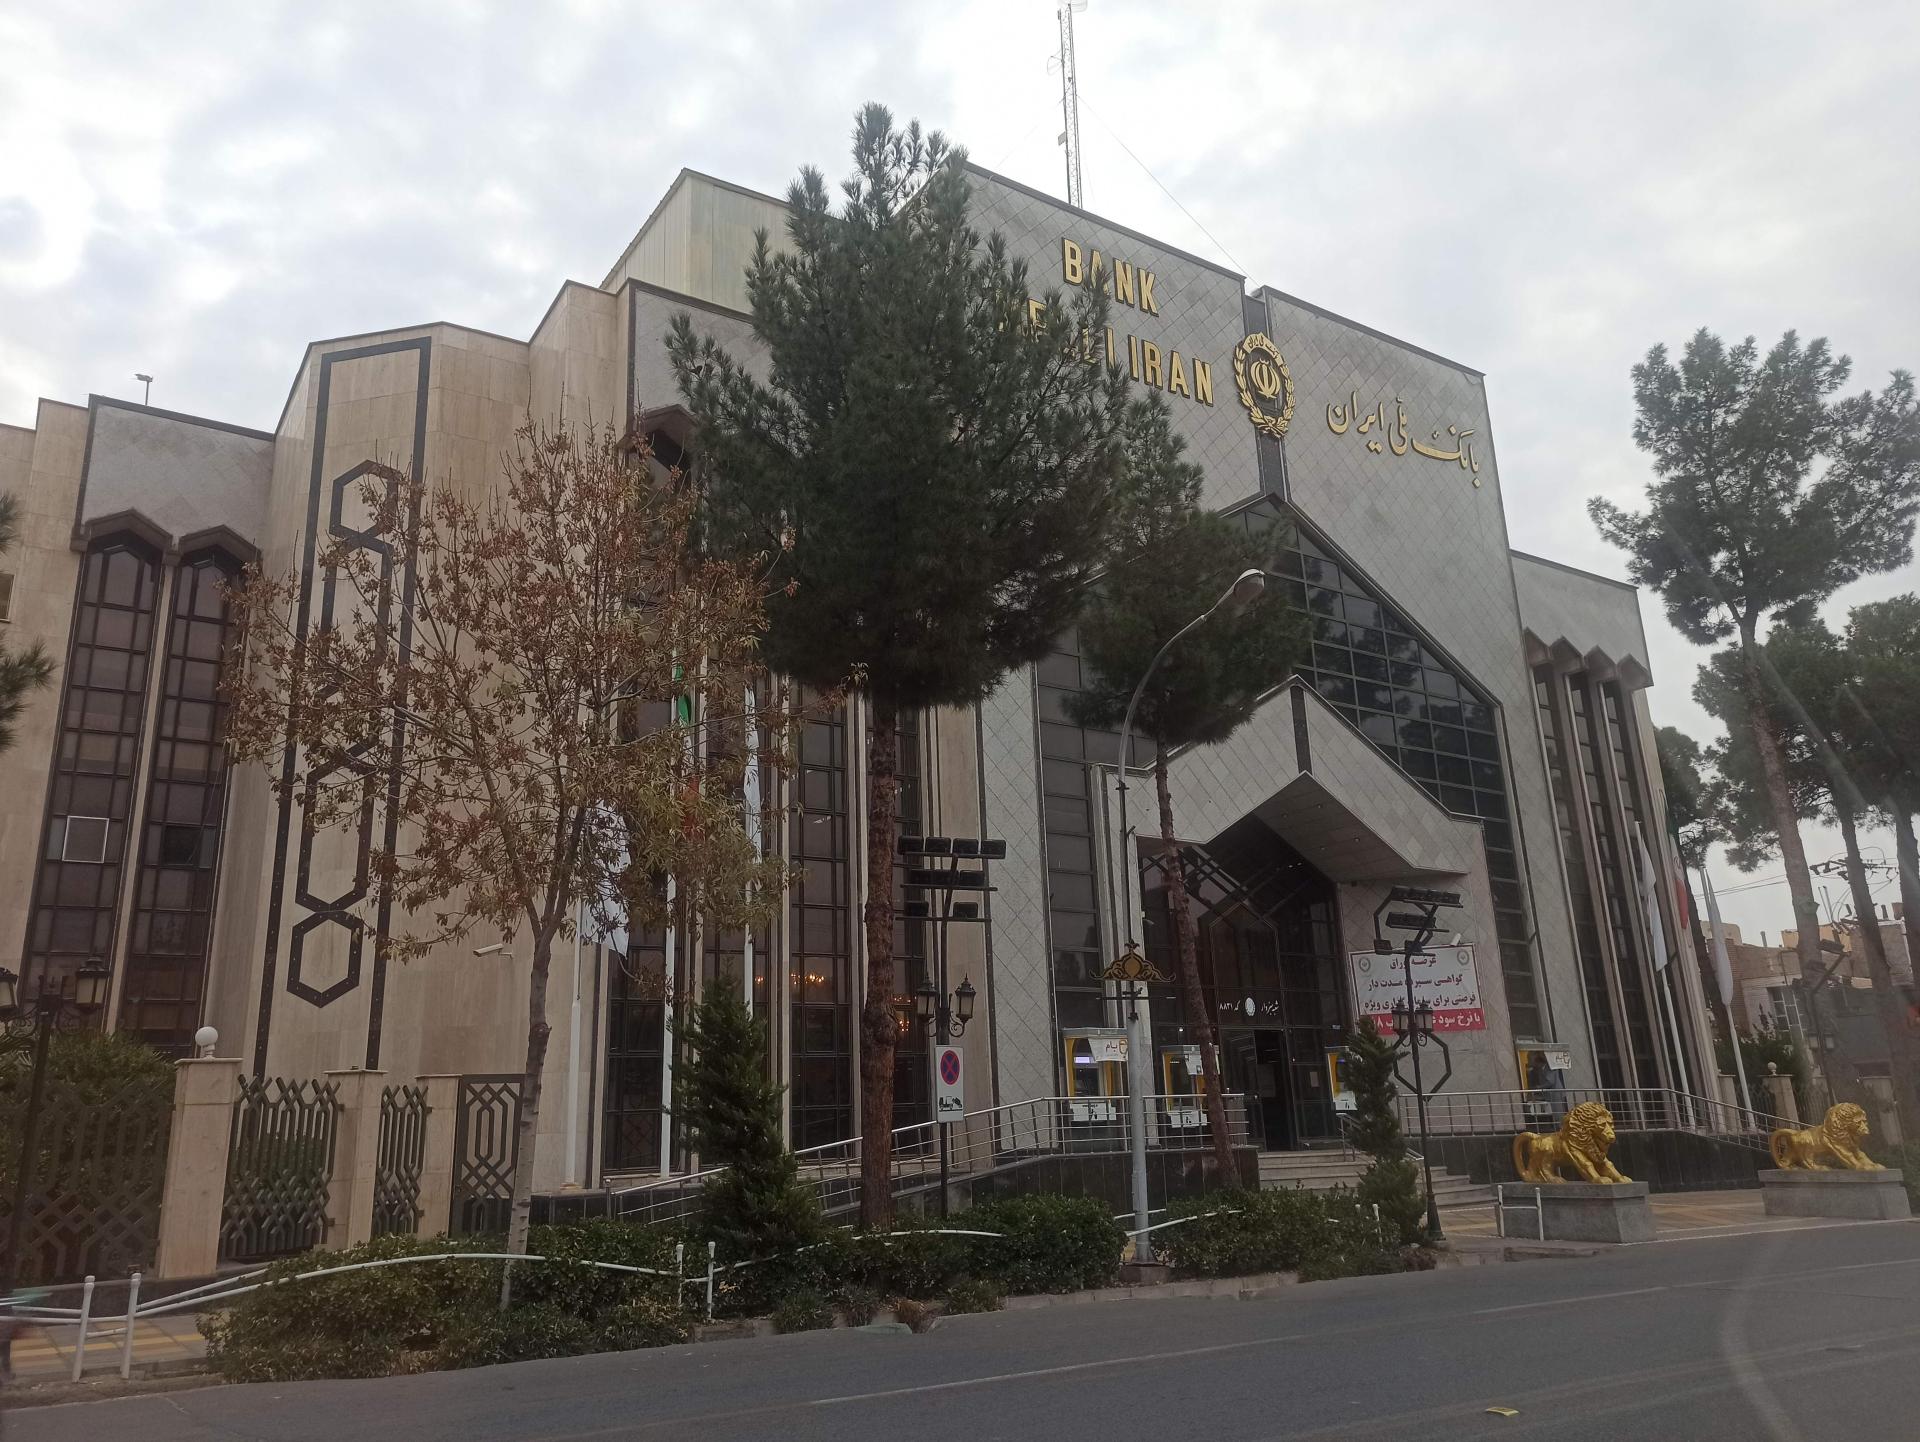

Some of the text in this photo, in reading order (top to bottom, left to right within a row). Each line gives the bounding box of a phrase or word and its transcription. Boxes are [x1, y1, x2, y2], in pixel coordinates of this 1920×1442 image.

[1061, 236, 1159, 318] BANK
[1127, 333, 1214, 408] IRAN
[1326, 390, 1384, 454] ایران
[1411, 423, 1481, 488] بانک
